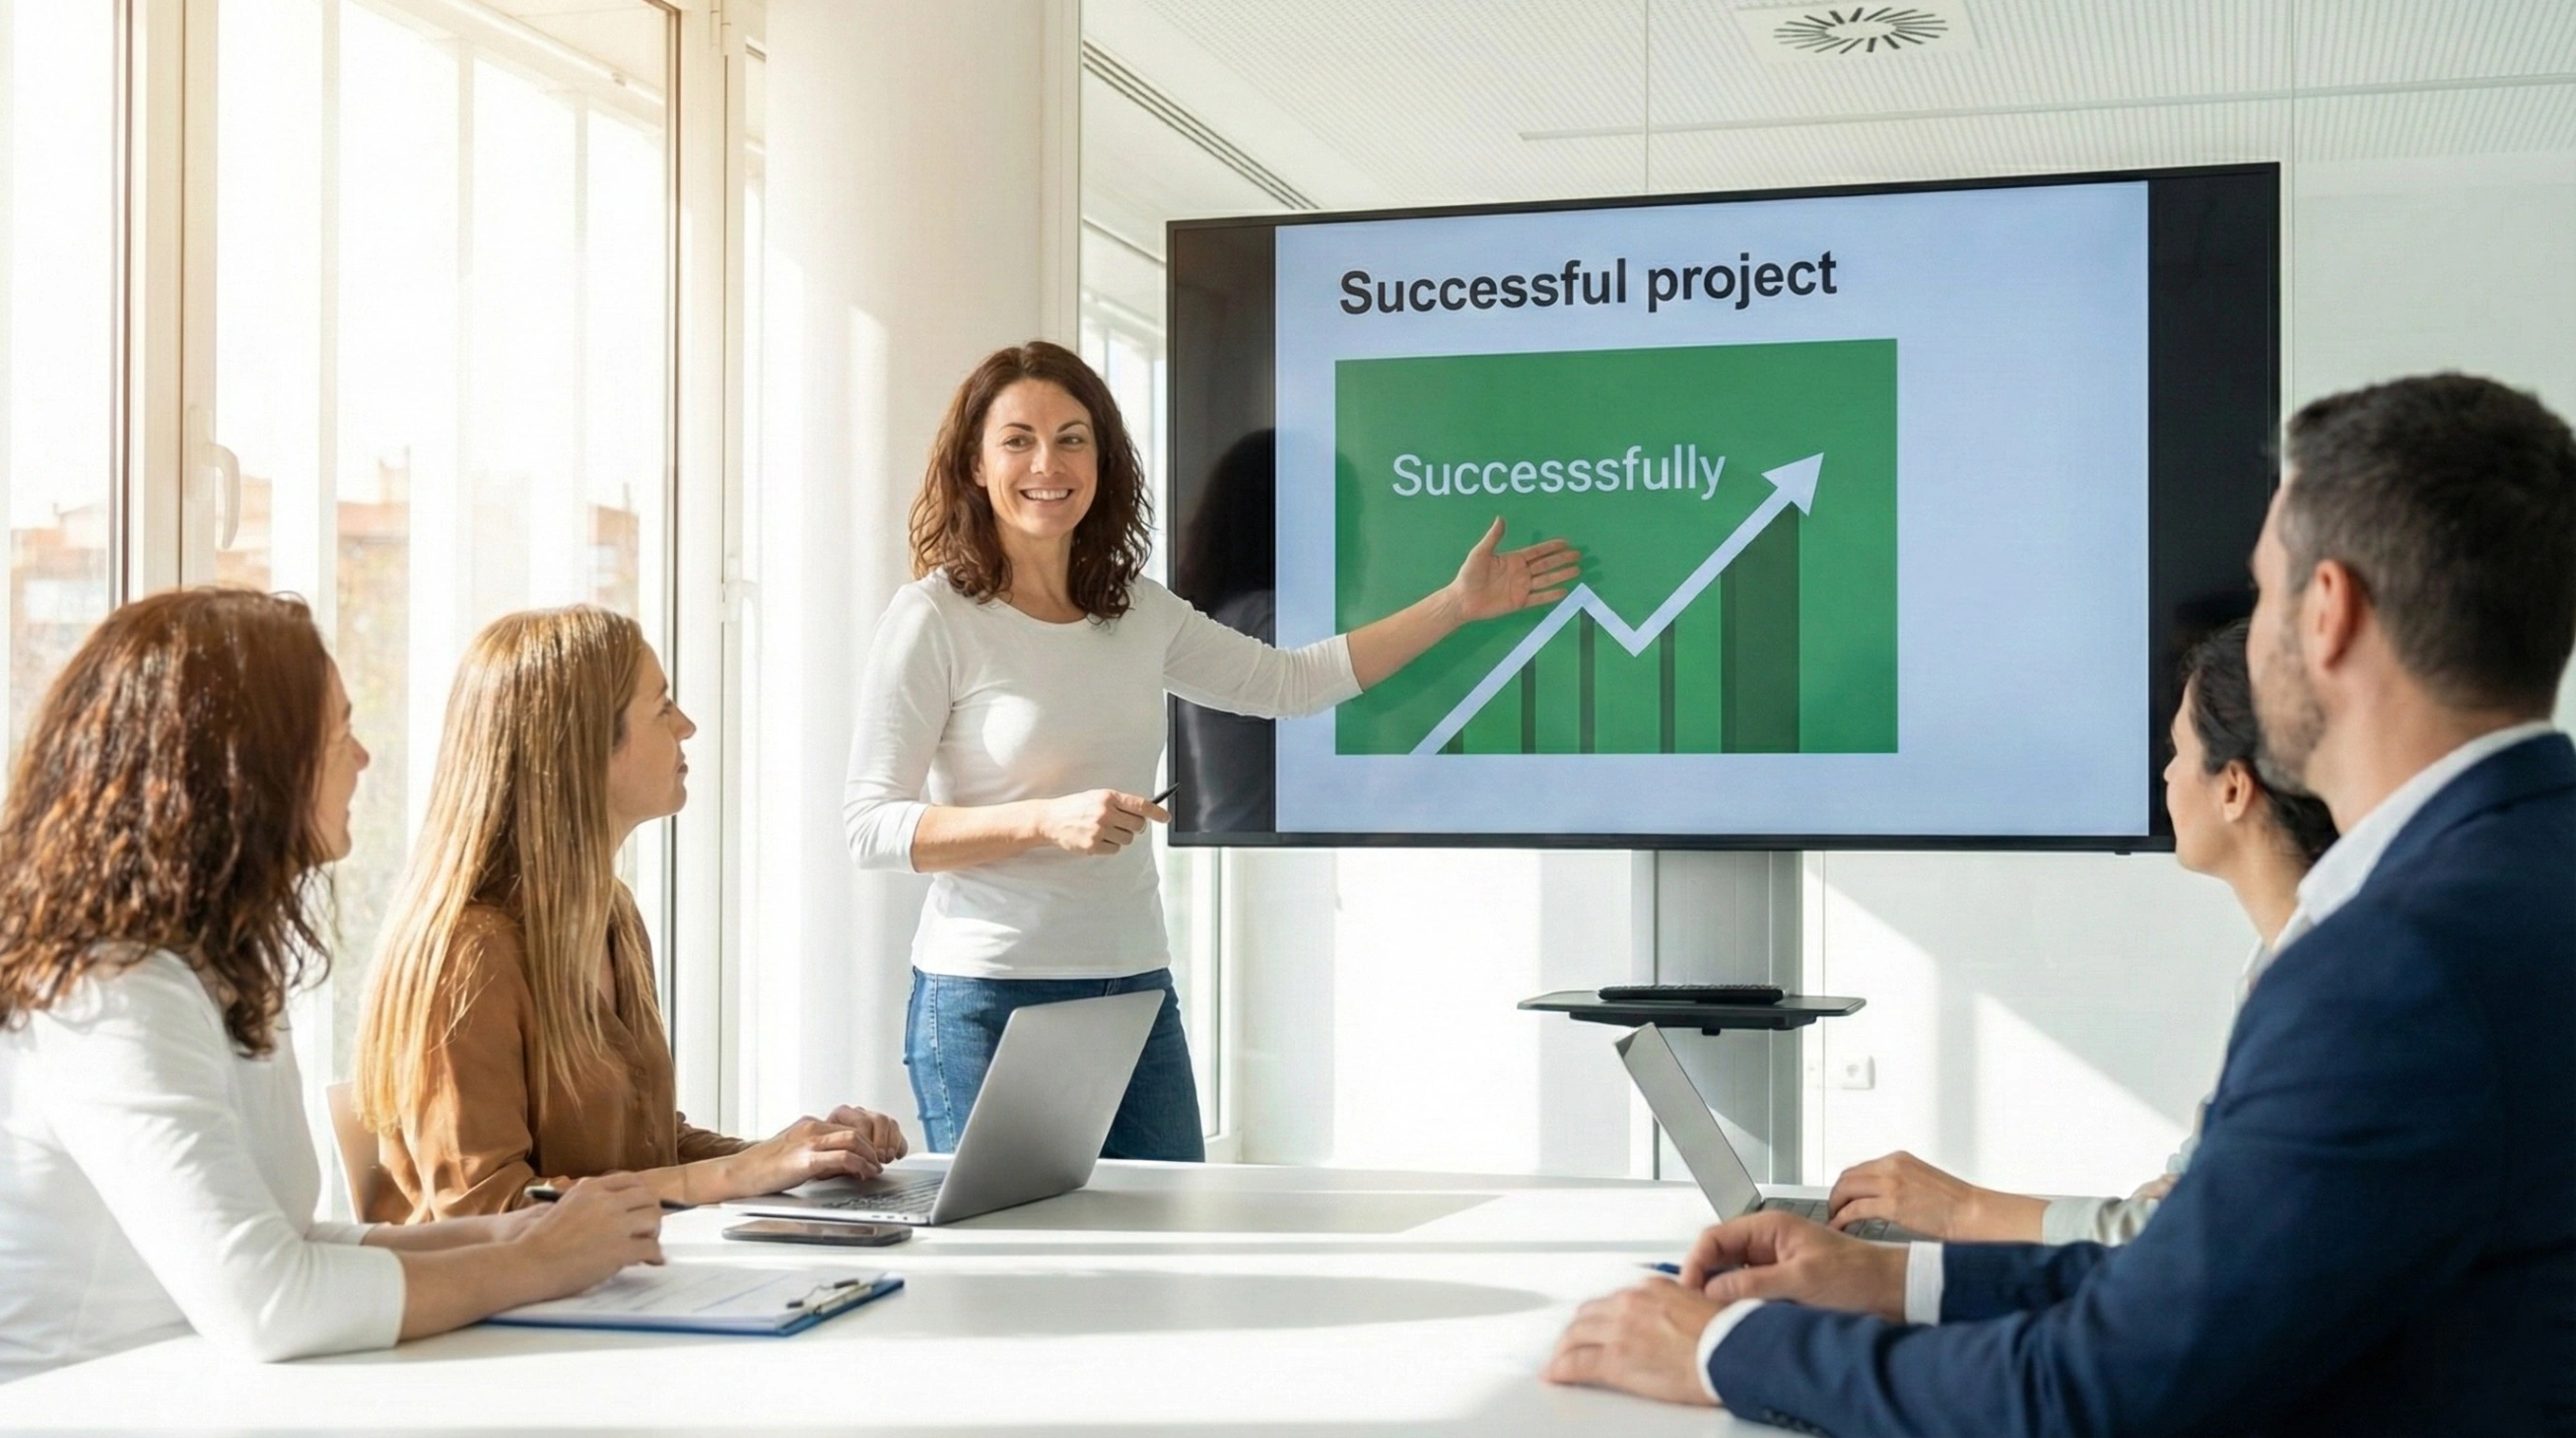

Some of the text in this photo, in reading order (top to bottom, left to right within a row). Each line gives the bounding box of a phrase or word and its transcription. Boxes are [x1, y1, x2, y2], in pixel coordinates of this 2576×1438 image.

[1340, 250, 1838, 315] Successful project
[1391, 444, 1727, 501] Successsfully
